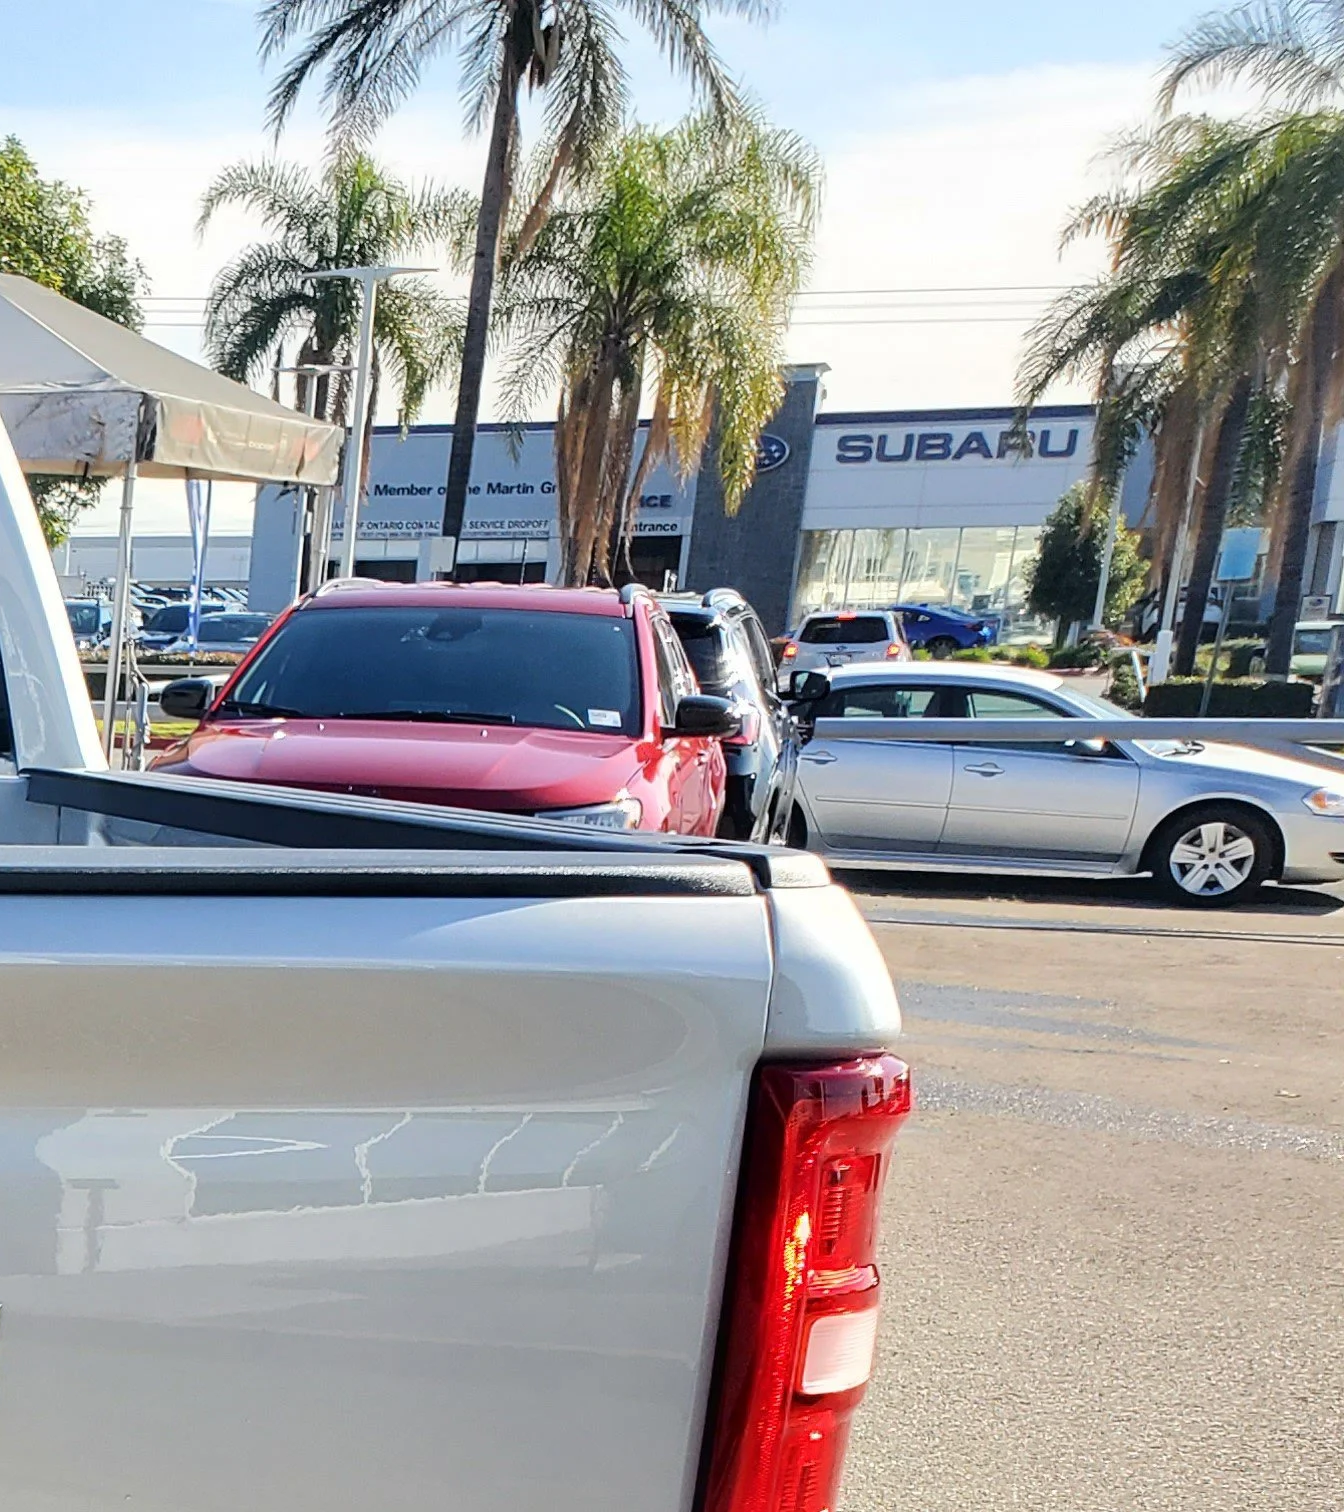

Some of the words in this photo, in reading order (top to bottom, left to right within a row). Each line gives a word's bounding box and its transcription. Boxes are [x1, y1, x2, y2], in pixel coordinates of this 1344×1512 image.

[835, 428, 1080, 464] SUBARU
[374, 484, 433, 497] Member
[486, 482, 535, 495] Martin
[366, 520, 404, 530] ONTARIO
[469, 520, 505, 530] SERVICE
[507, 519, 549, 529] DROPOFF
